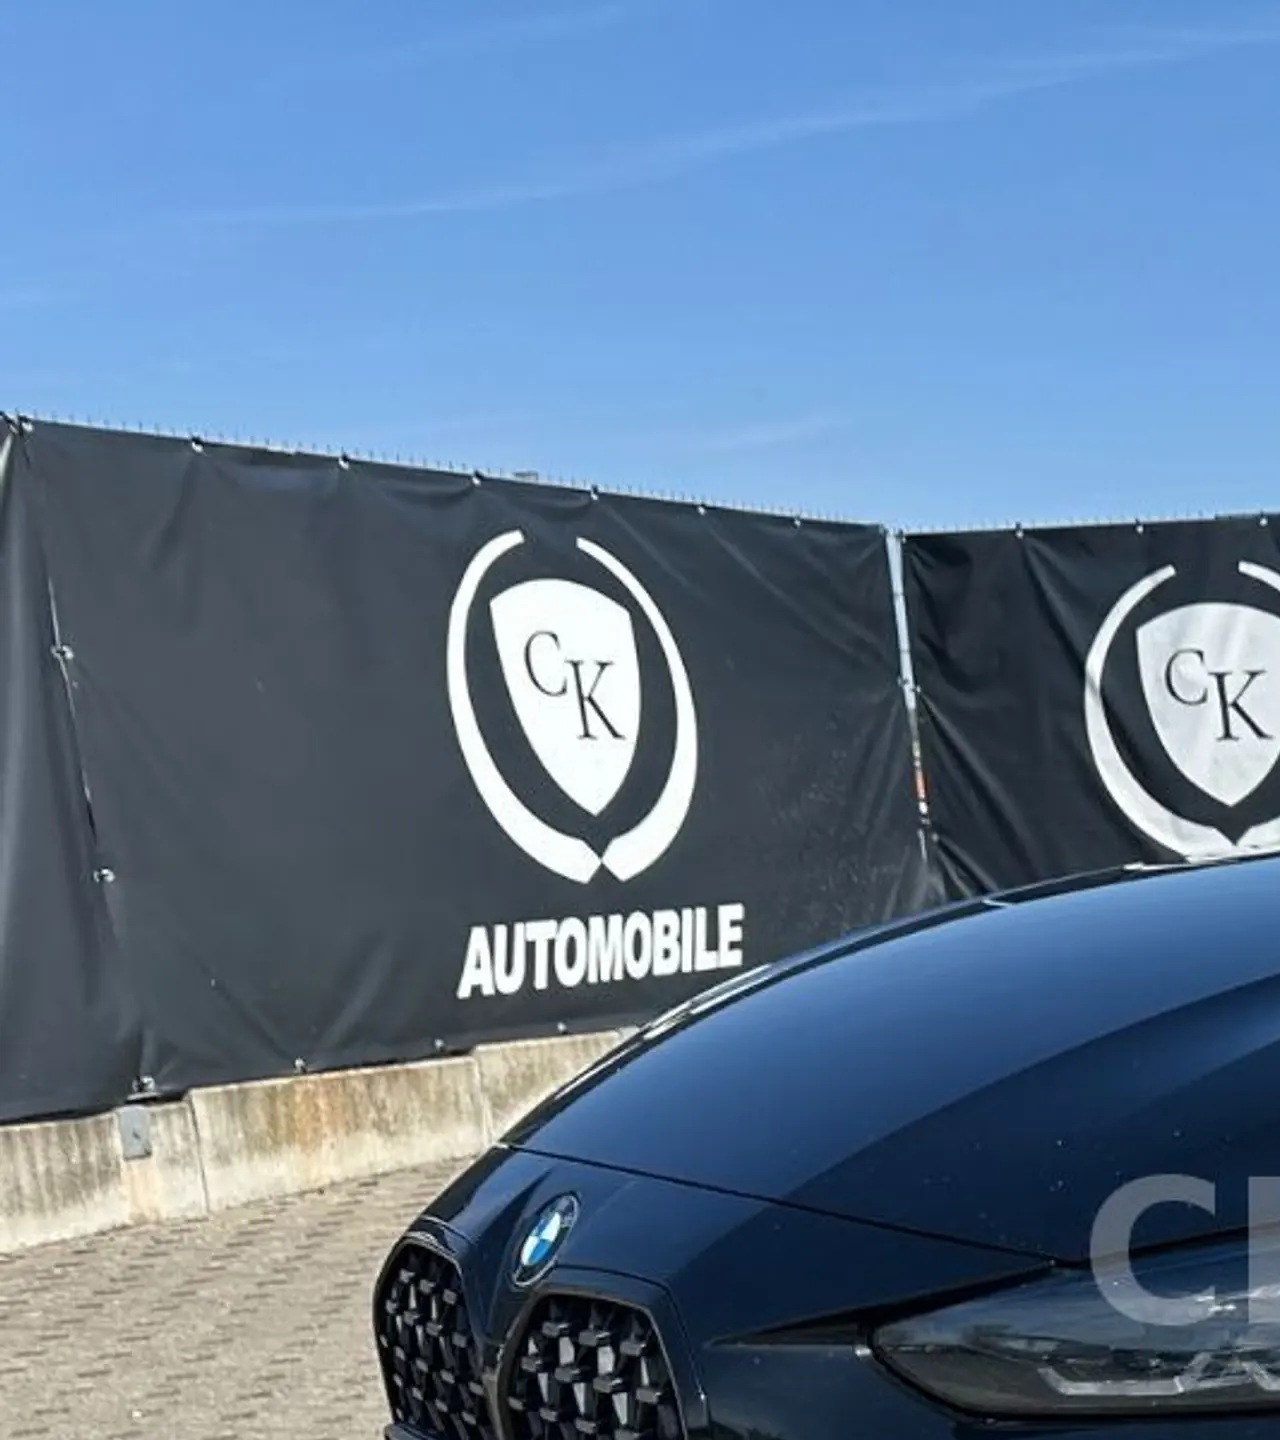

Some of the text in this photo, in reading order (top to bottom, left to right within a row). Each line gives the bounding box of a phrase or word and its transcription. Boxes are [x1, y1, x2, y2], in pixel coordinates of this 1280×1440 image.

[523, 631, 626, 740] CK
[1165, 648, 1274, 741] CK
[456, 903, 745, 998] AUTOMOBILE
